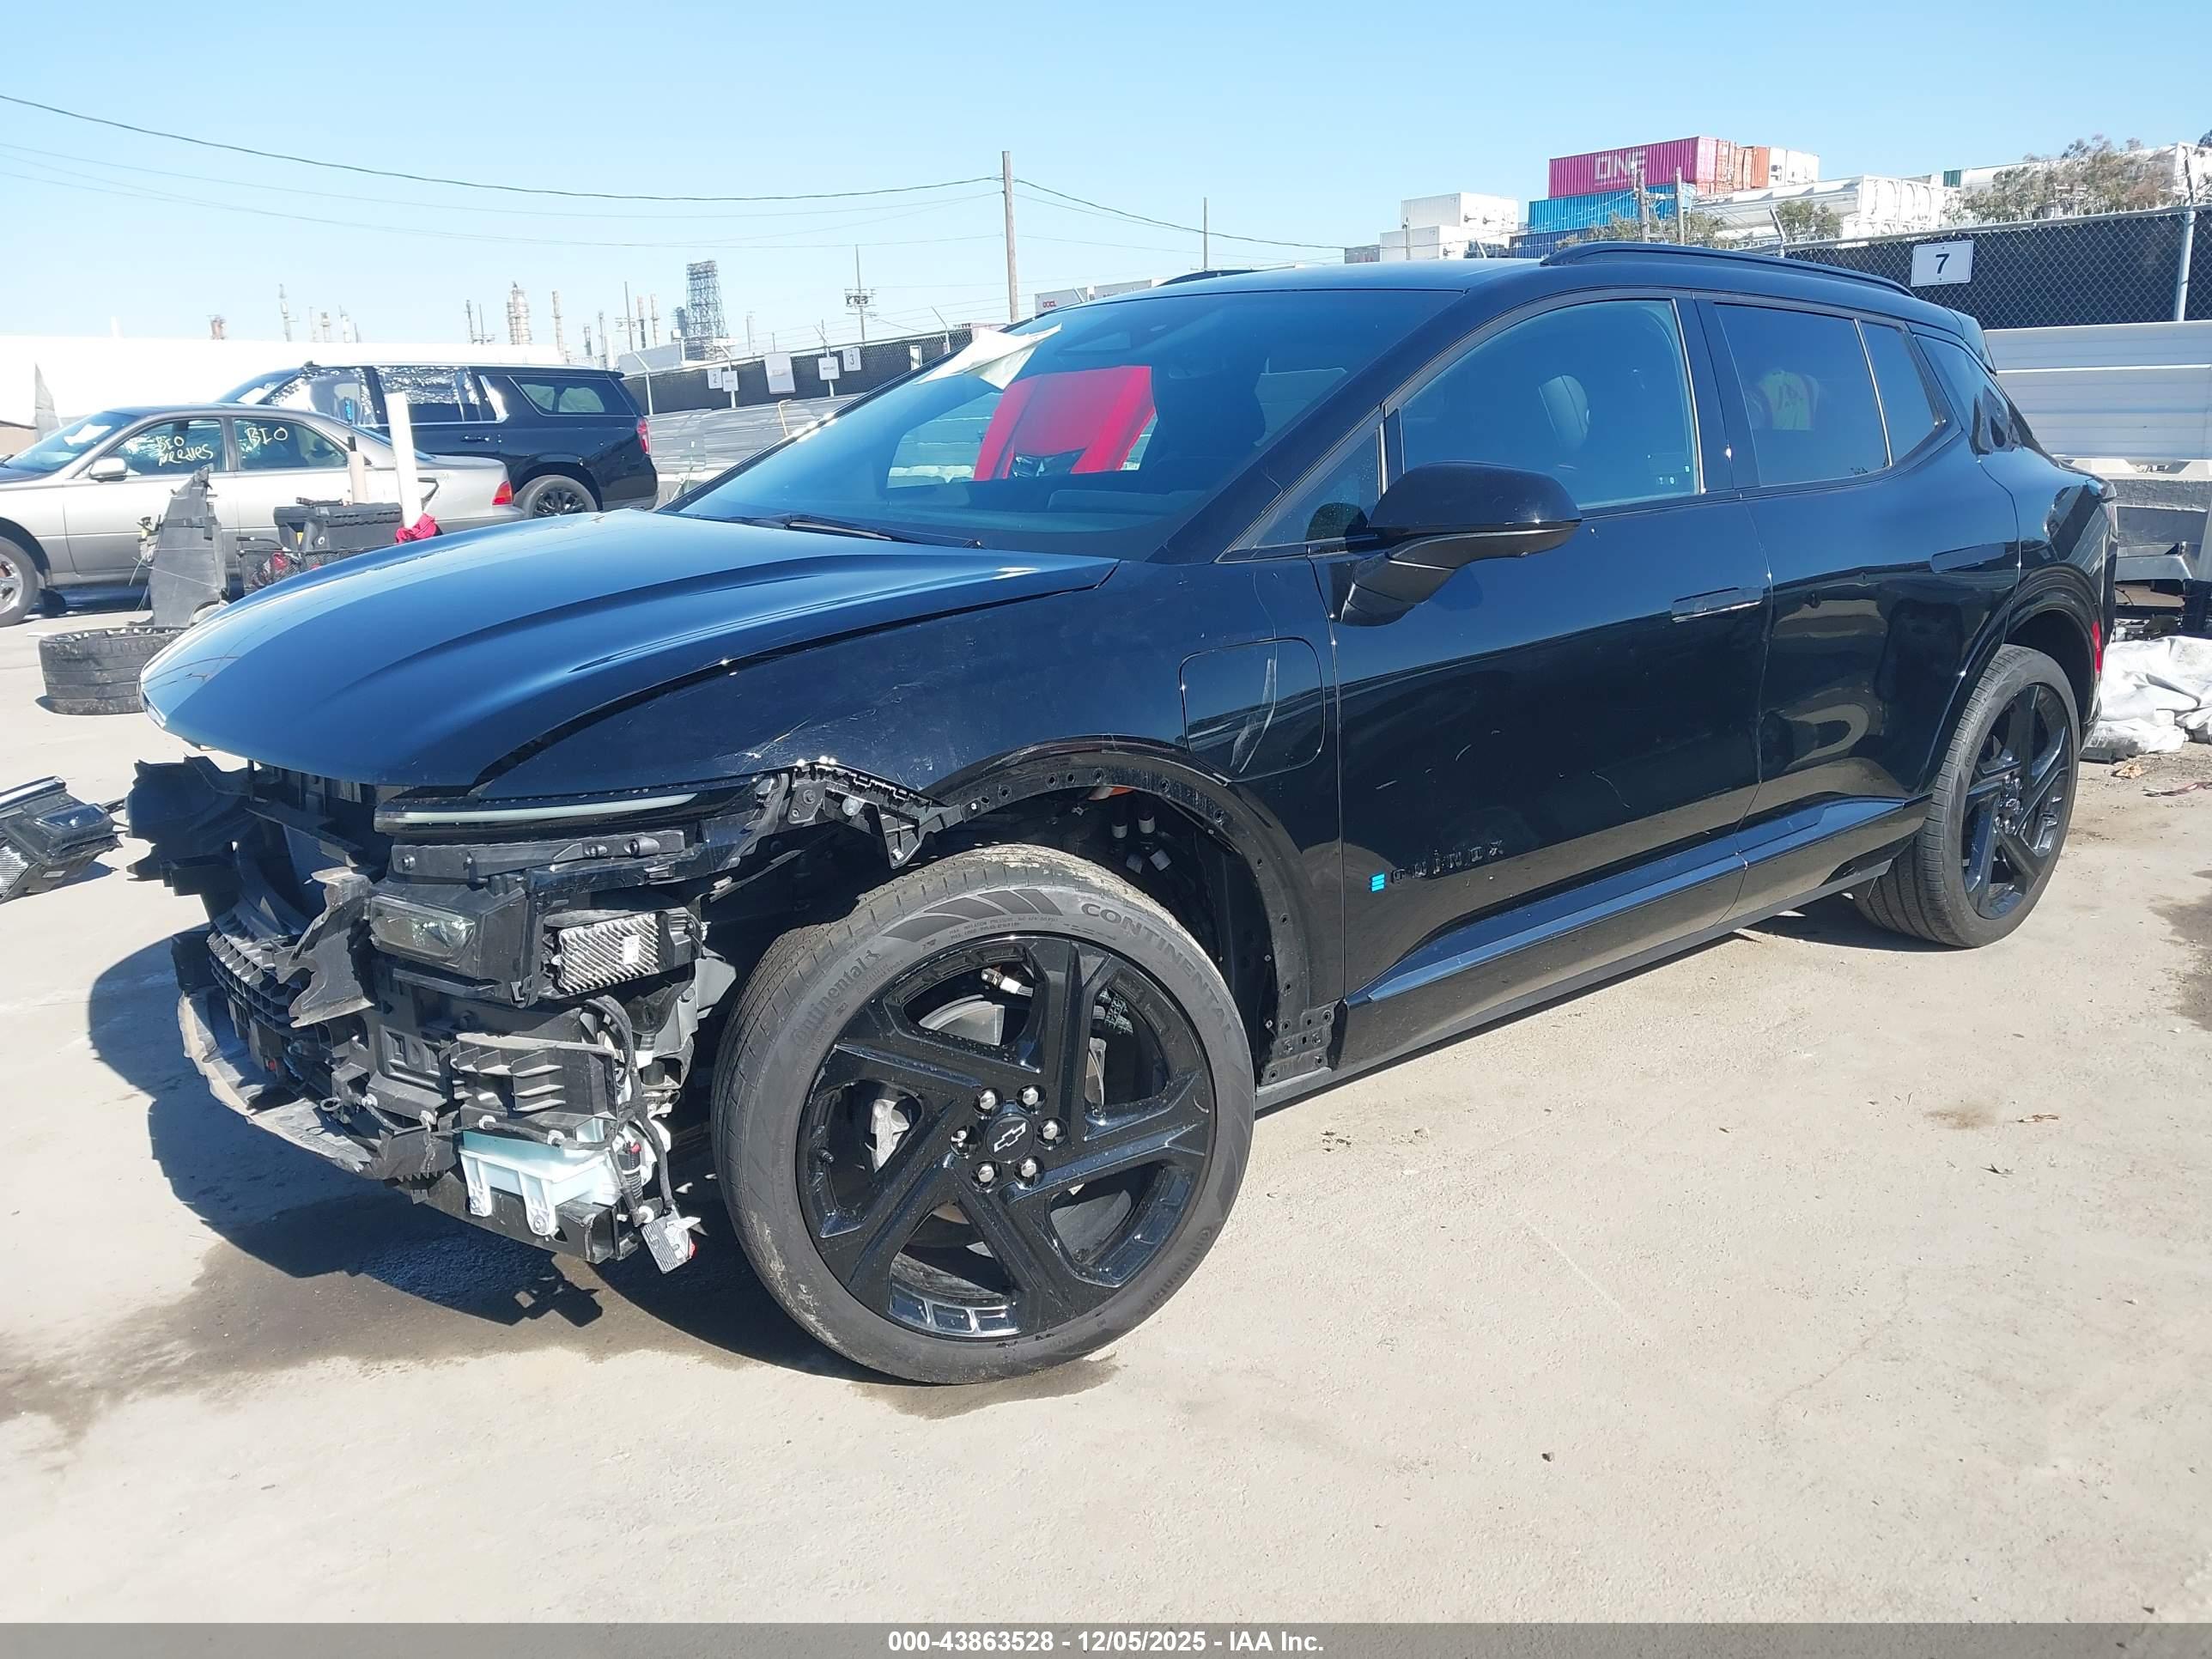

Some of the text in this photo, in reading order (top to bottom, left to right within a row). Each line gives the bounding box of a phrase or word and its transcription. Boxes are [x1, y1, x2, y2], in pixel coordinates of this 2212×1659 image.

[1936, 252, 1950, 275] 7
[245, 427, 289, 447] BIO
[1081, 902, 1231, 1043] CONTINENTAL
[789, 957, 869, 1047] Continental
